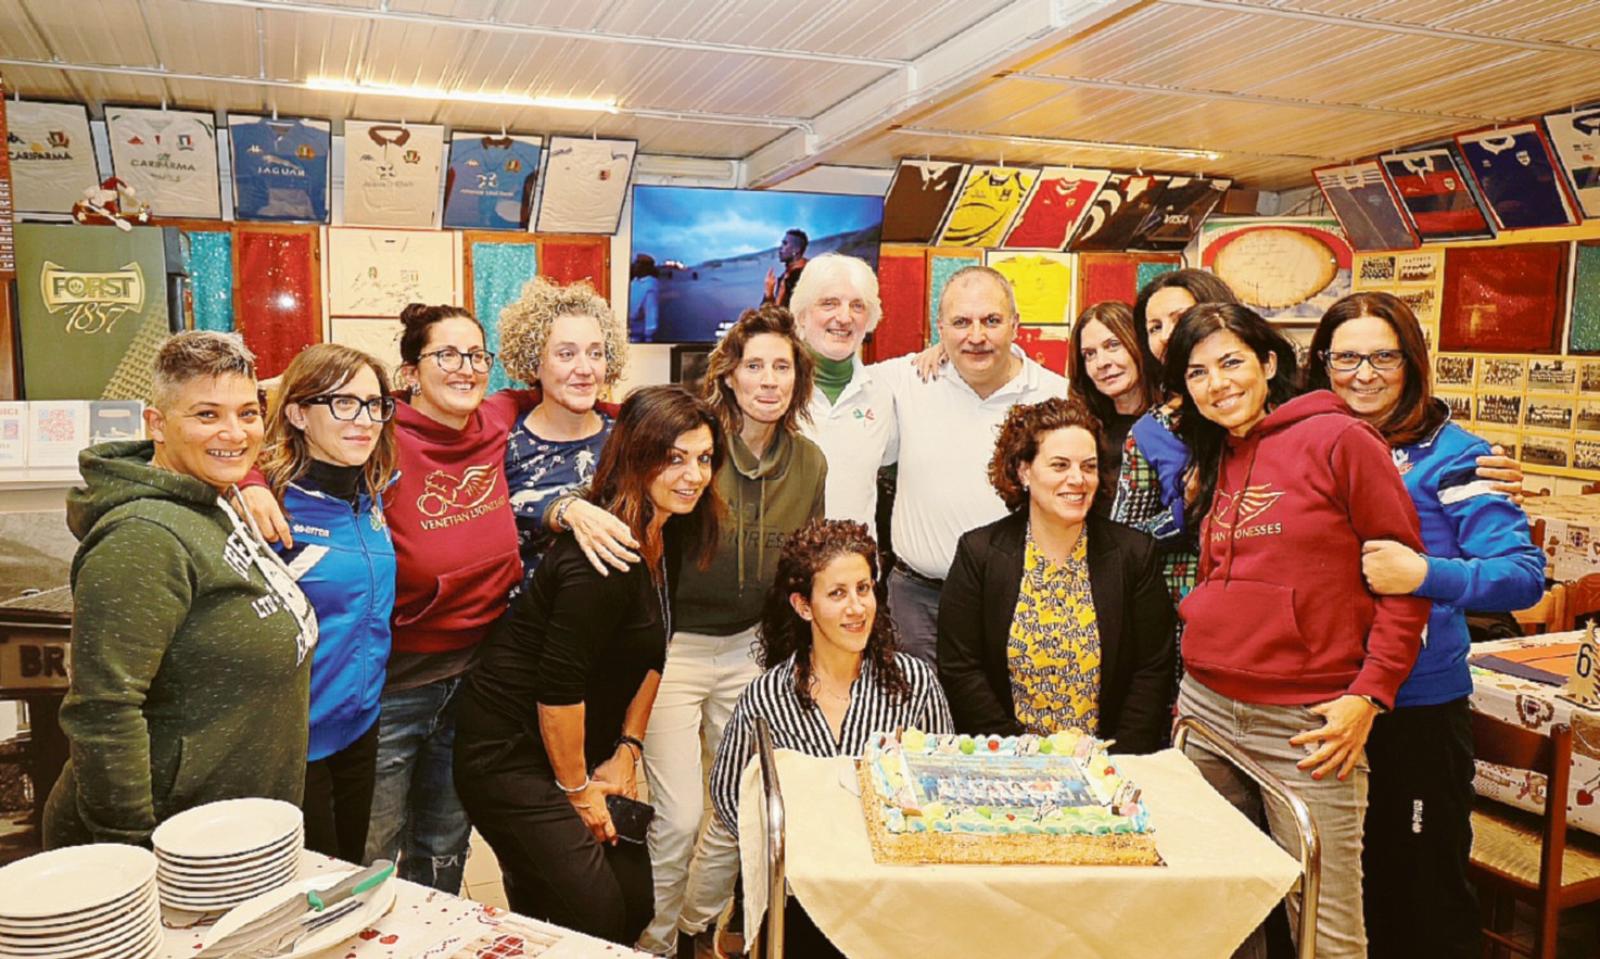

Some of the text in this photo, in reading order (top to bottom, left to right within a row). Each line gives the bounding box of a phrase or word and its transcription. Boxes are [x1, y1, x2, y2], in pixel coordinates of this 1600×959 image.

[257, 166, 305, 176] JAGUAR
[53, 276, 135, 298] FORST
[64, 301, 129, 334] 1857
[420, 512, 471, 530] VENETIAN
[1577, 643, 1593, 678] 6
